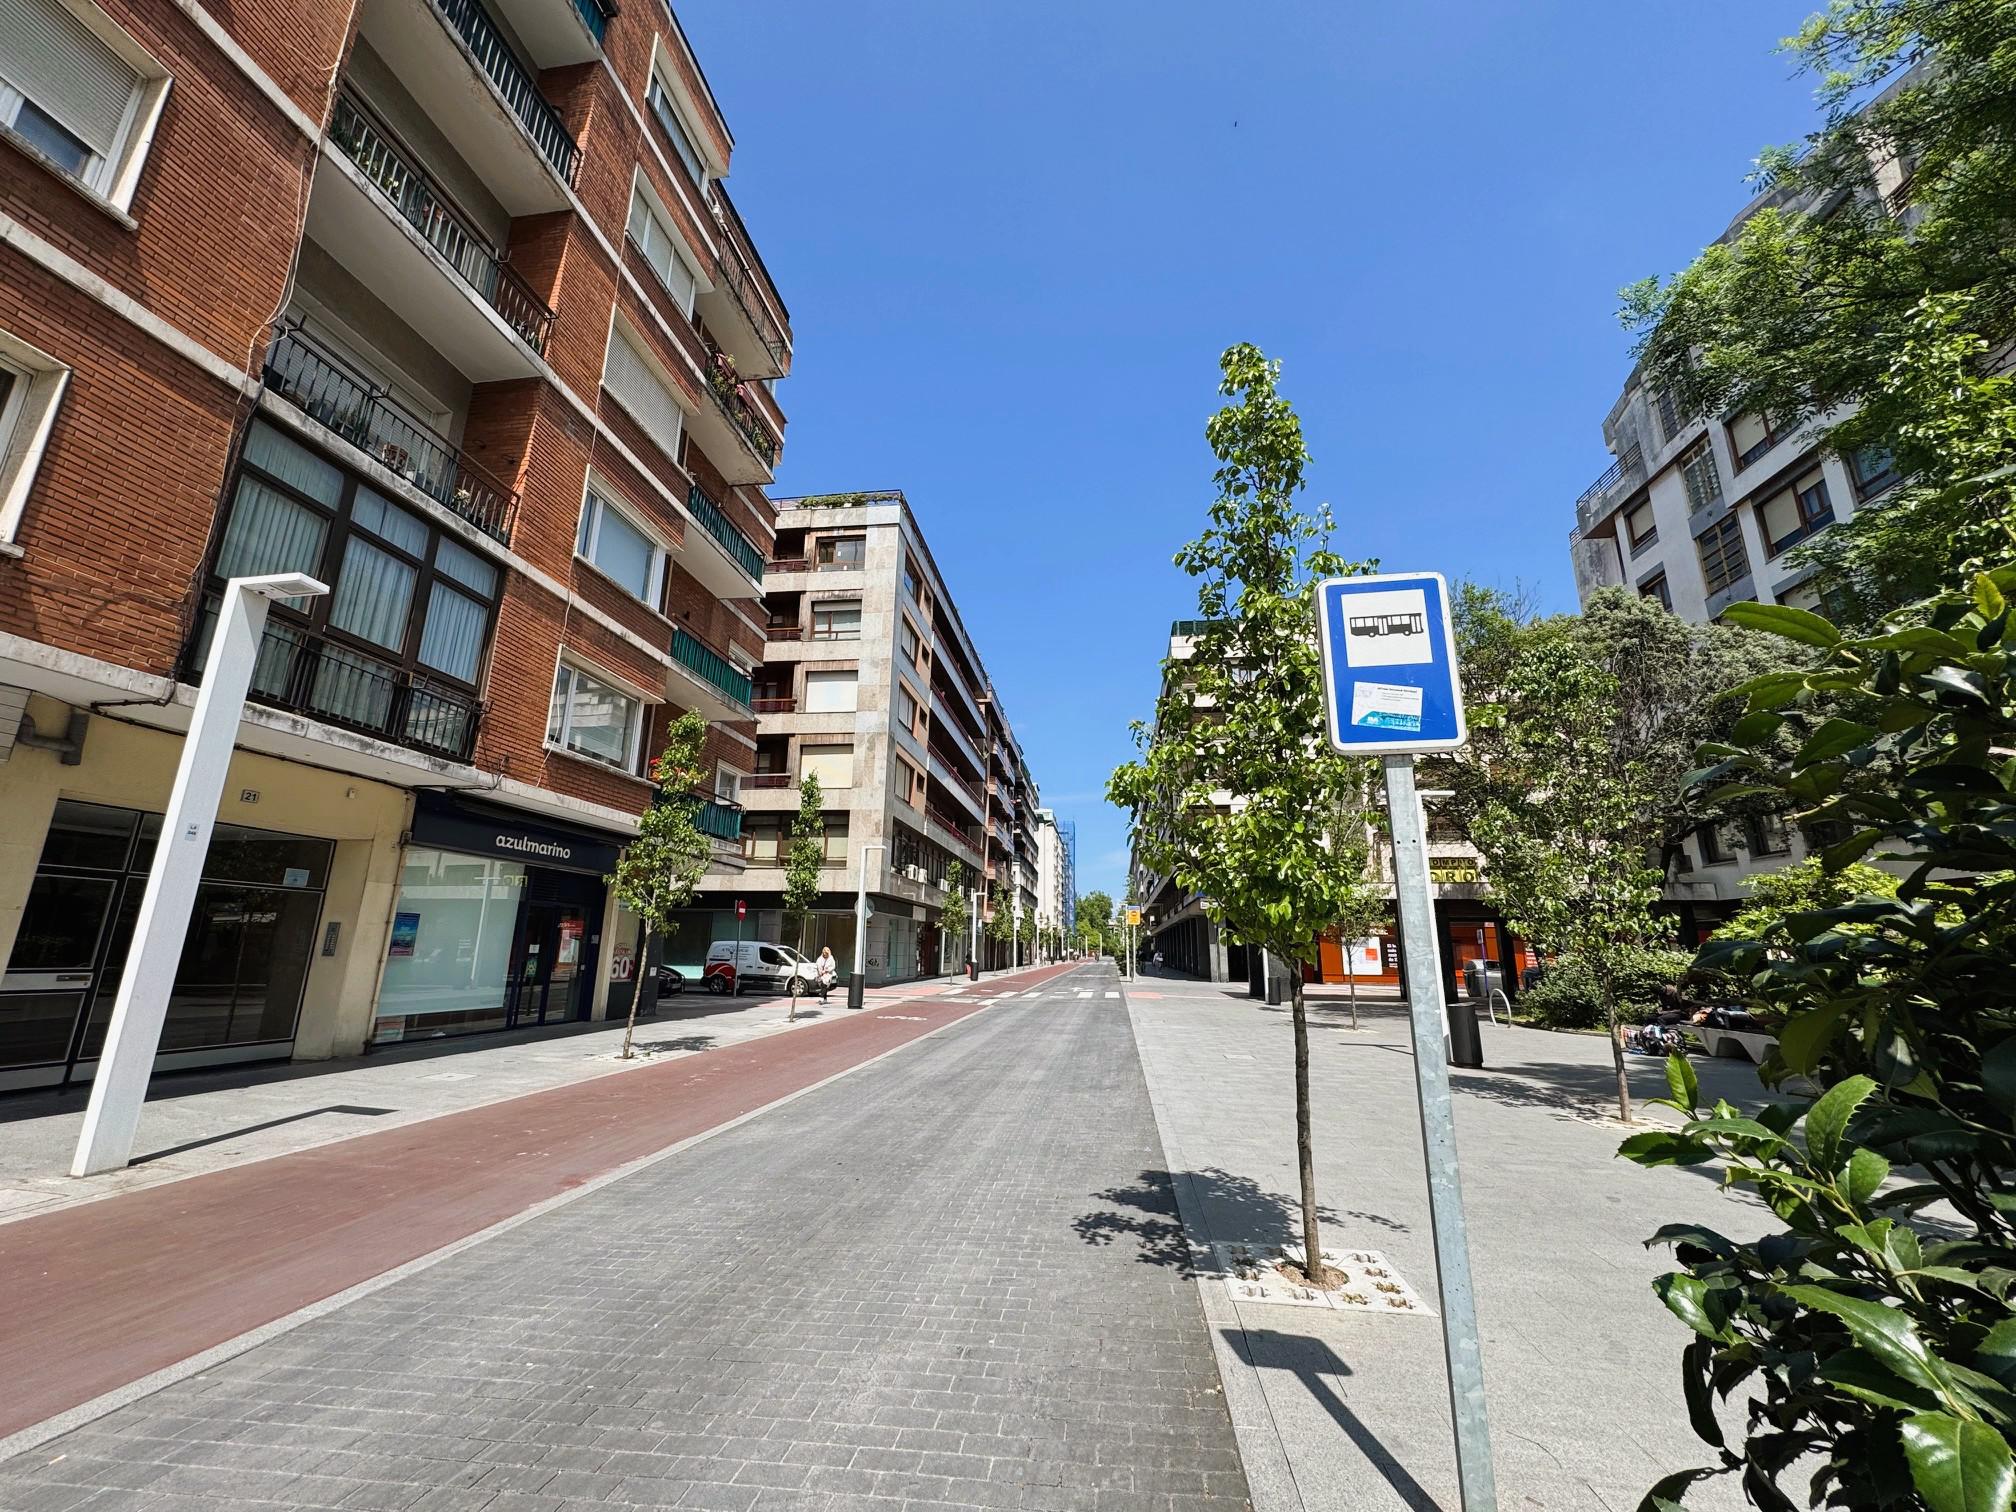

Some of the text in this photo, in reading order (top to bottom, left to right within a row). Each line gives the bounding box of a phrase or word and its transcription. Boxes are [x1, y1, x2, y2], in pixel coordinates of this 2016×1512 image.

[244, 791, 258, 802] 21
[495, 834, 571, 859] azulmarino
[1431, 858, 1474, 866] OMPO
